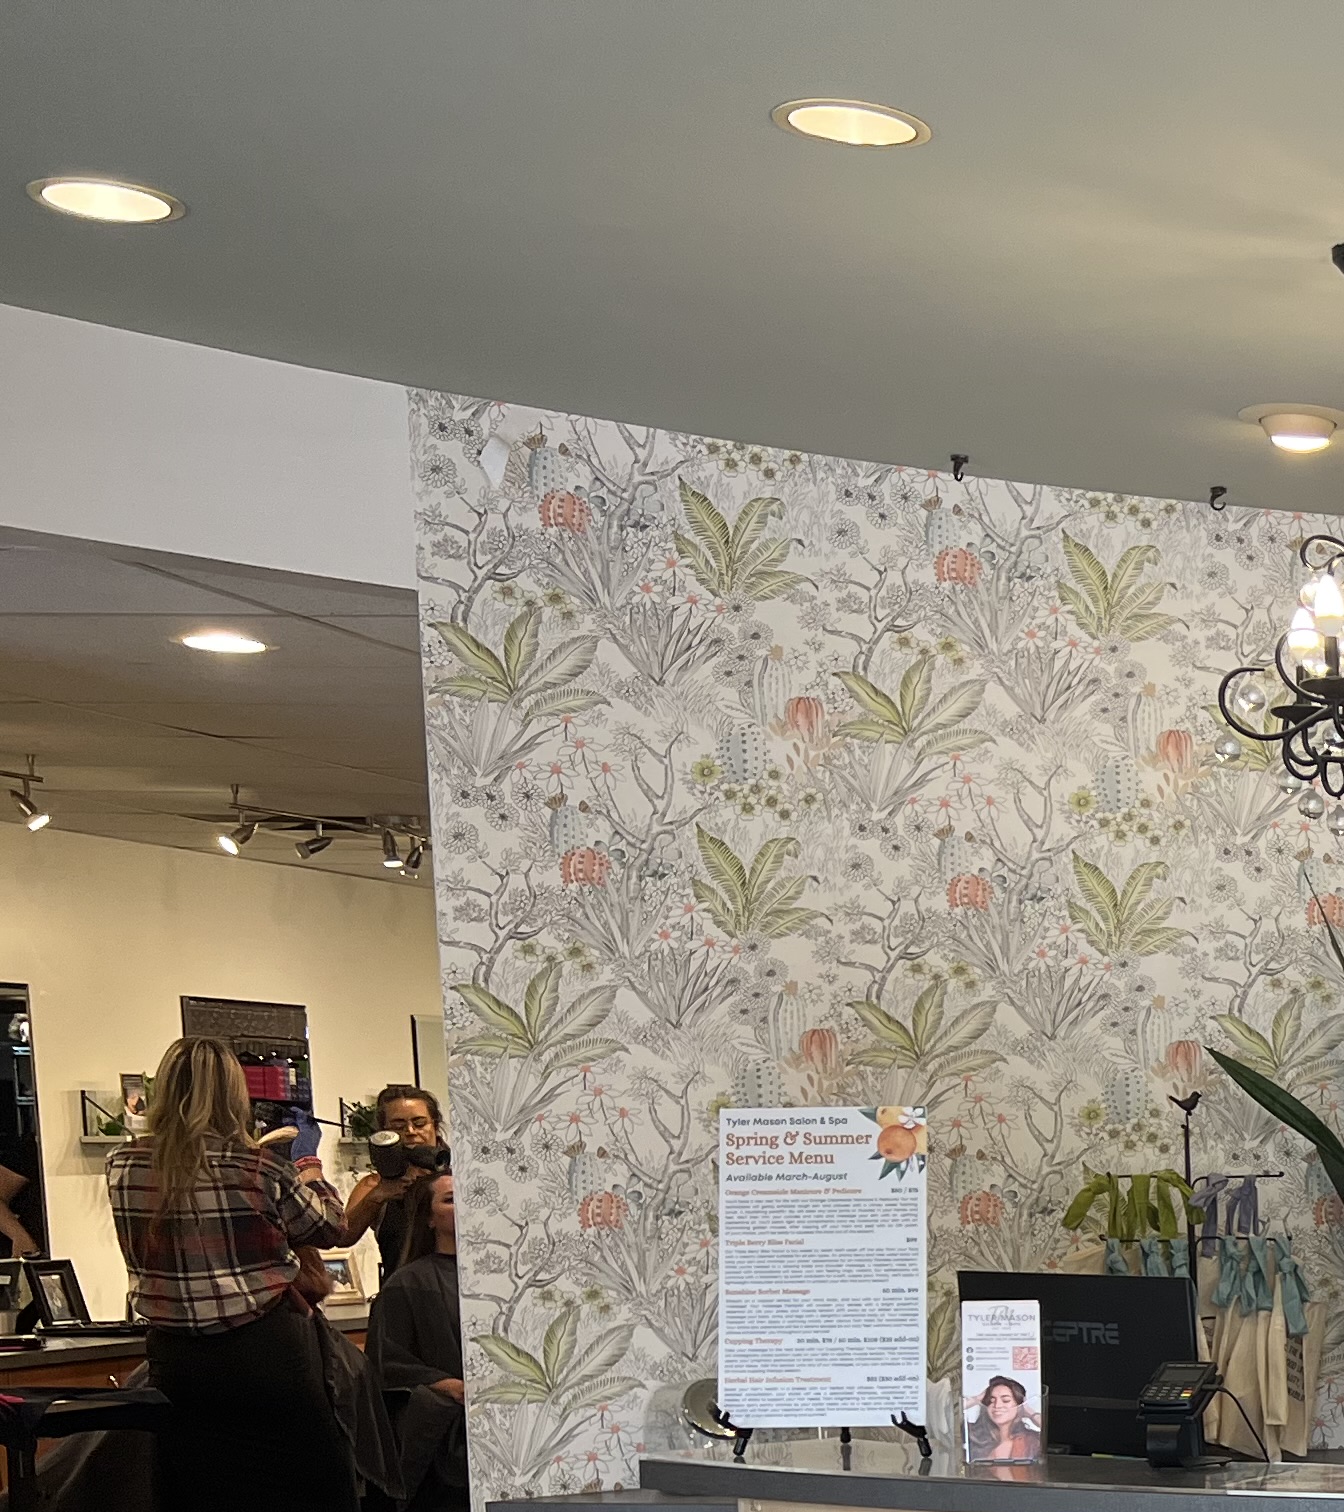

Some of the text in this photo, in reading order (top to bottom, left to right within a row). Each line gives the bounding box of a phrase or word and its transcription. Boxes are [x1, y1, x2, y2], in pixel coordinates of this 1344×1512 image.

[726, 1116, 848, 1127] Tyler Mason Salon & Spa
[725, 1130, 872, 1149] Spring & Summer
[725, 1151, 834, 1166] Service Menu
[726, 1172, 848, 1183] Available March-August
